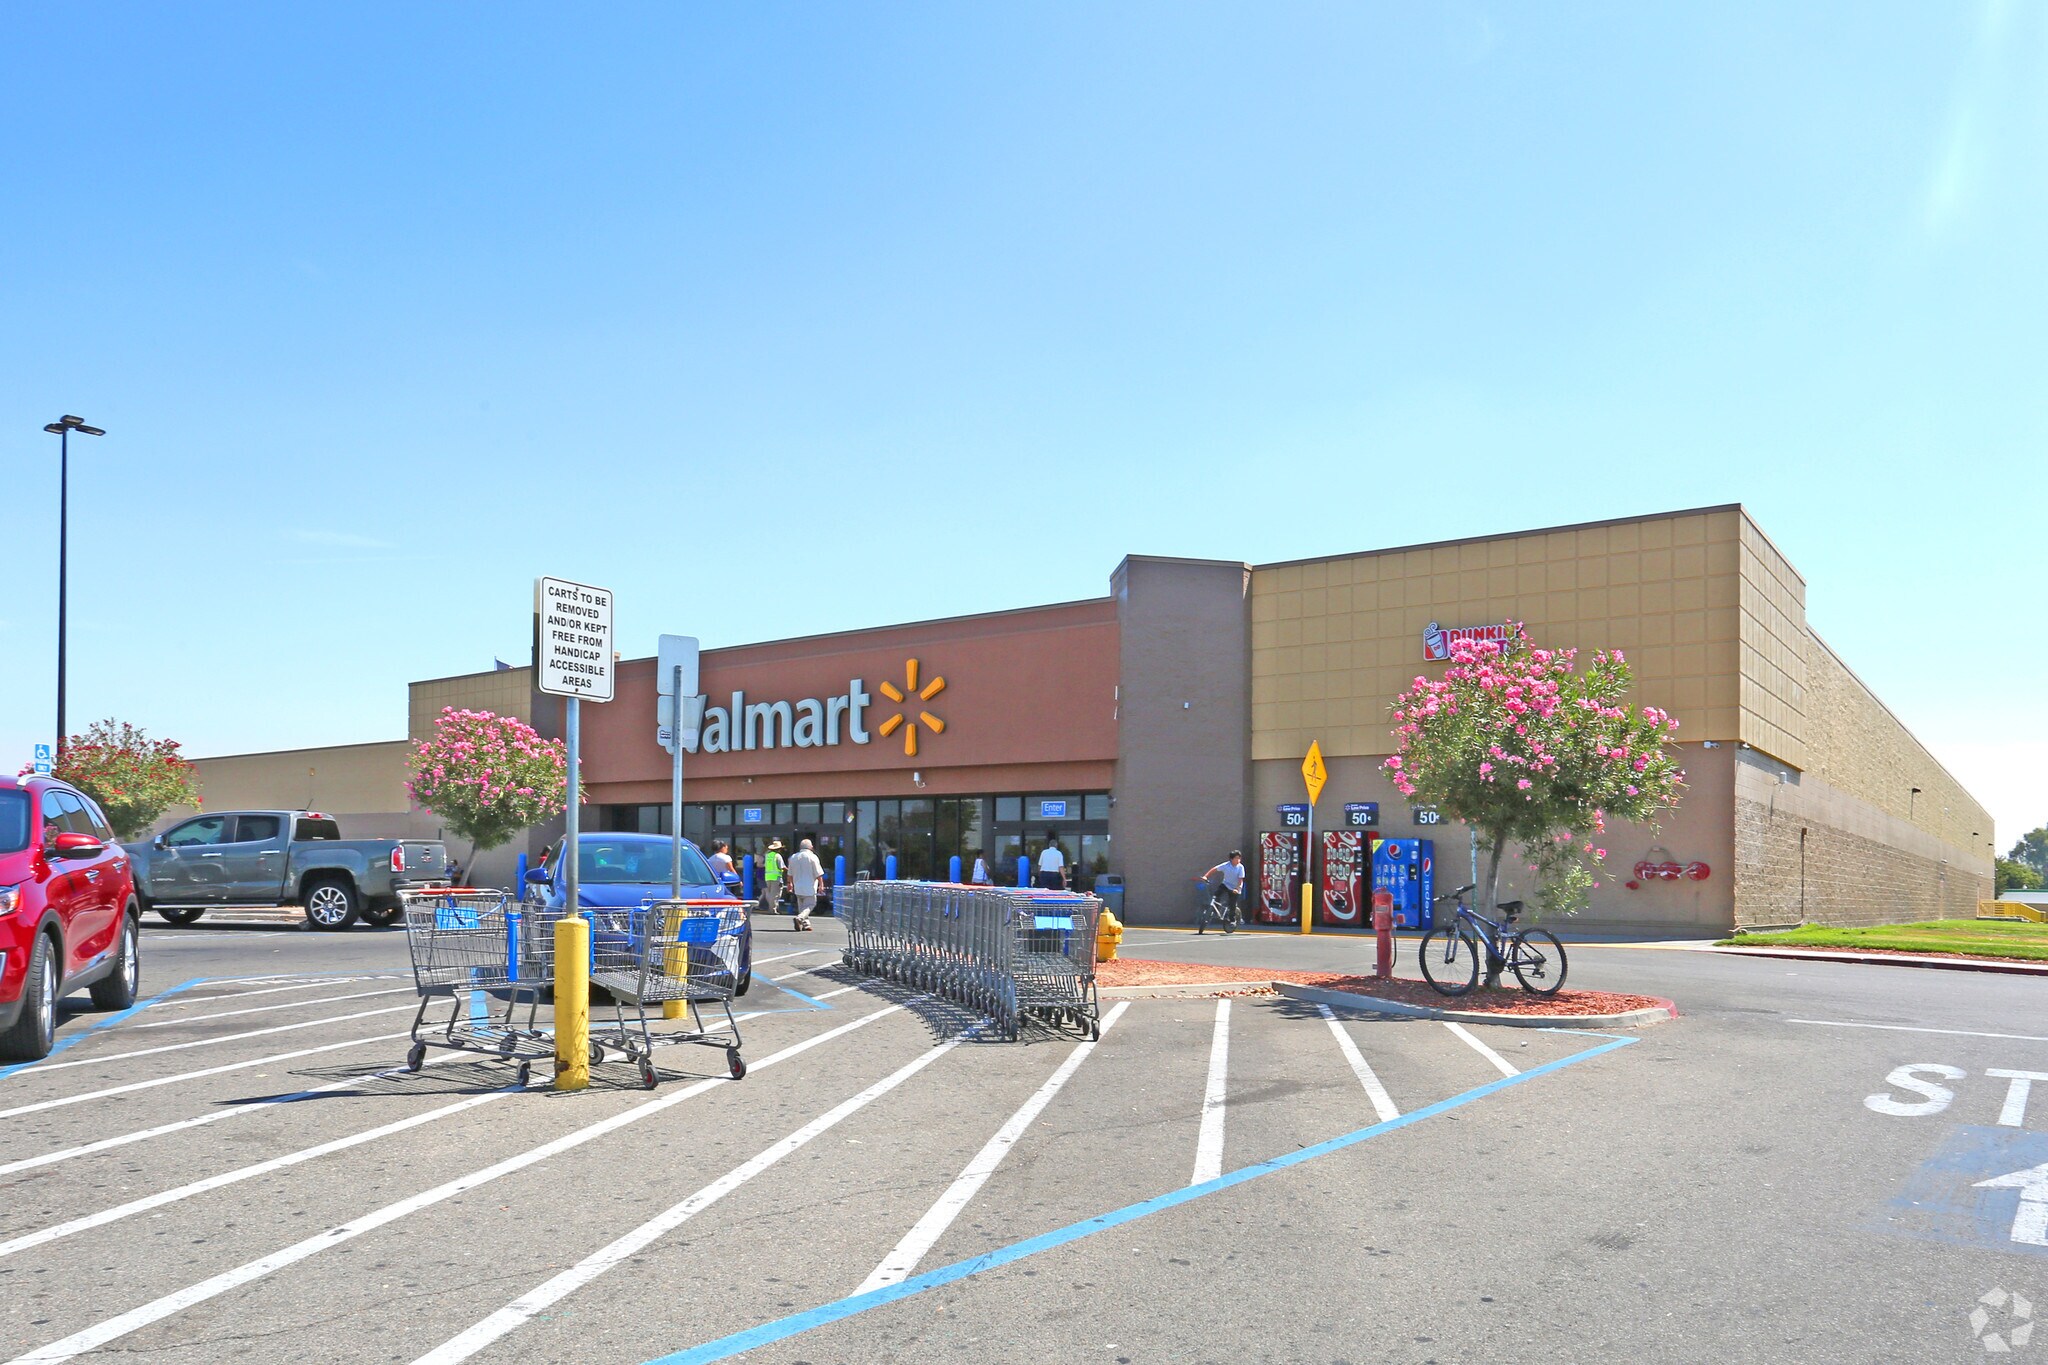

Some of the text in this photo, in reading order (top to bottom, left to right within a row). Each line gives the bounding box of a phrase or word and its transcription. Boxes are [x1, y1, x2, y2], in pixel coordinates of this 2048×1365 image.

[548, 586, 607, 607] CARTS TO BE
[556, 602, 599, 619] REMOVED
[547, 615, 607, 634] AND/OR KEPT
[552, 630, 603, 648] FREE FROM
[554, 645, 601, 661] HANDICAP
[549, 659, 605, 676] ACCESSIBLE
[562, 675, 592, 688] AREAS
[1044, 803, 1062, 811] Enter
